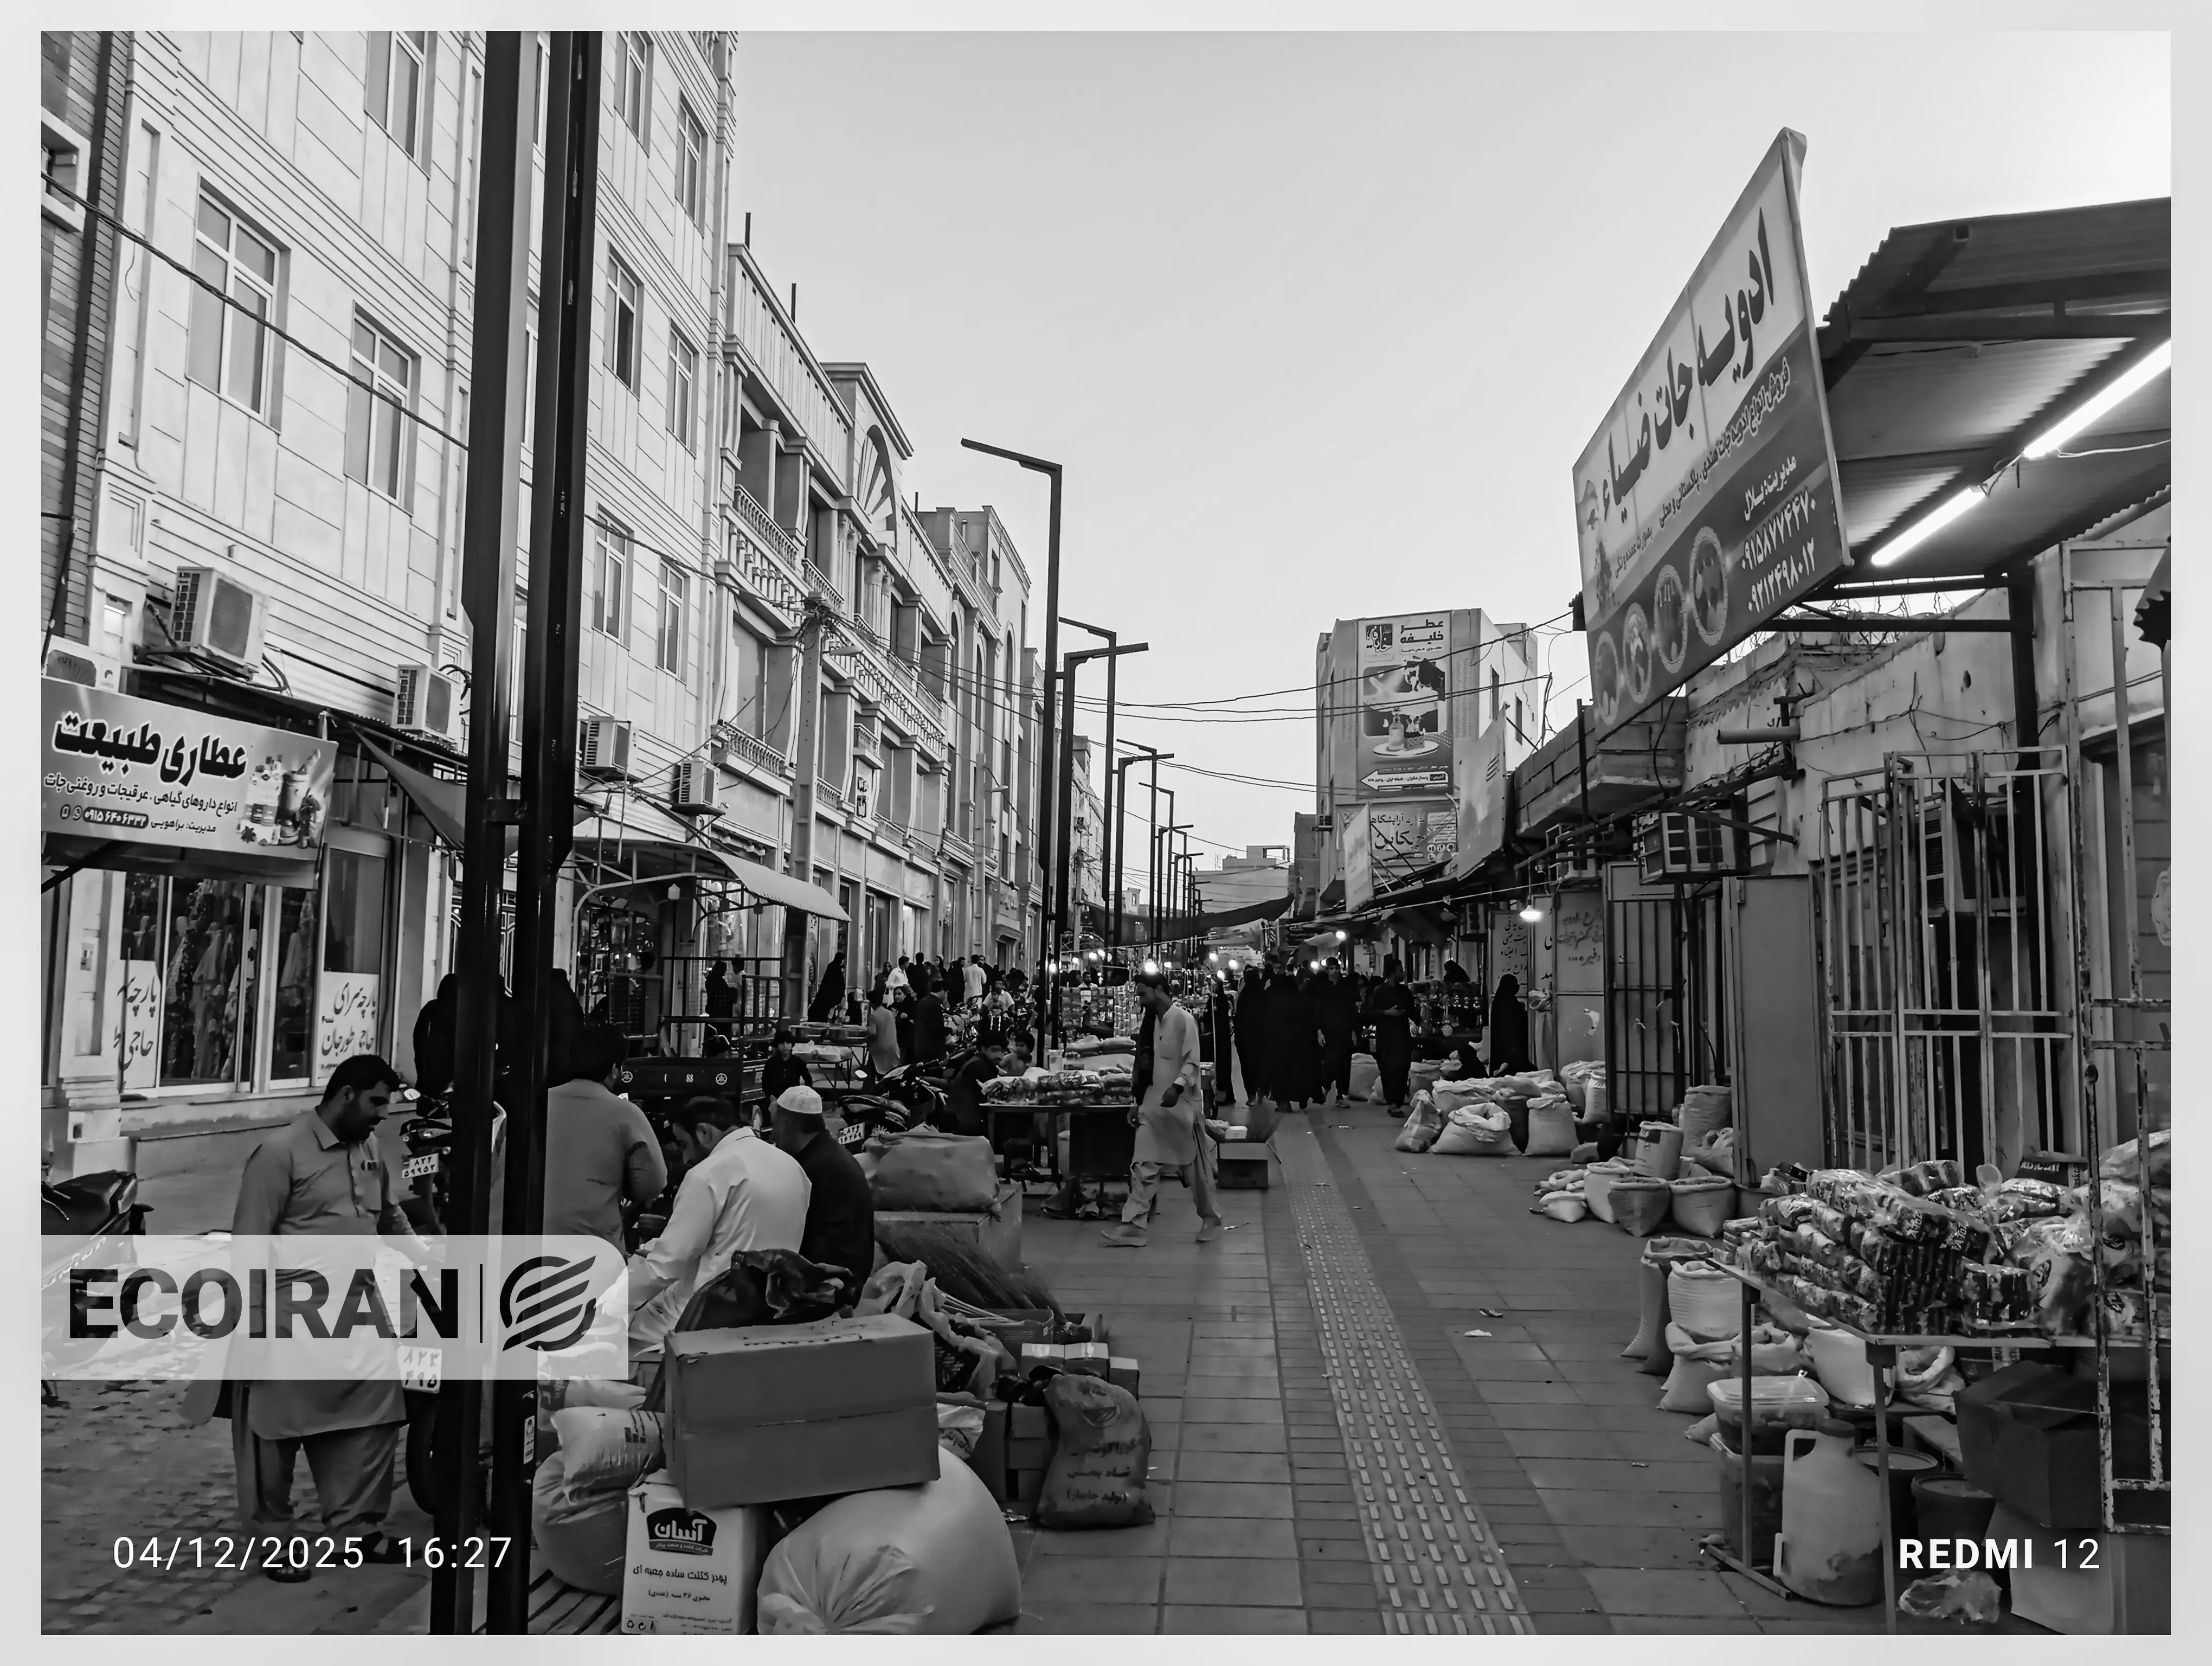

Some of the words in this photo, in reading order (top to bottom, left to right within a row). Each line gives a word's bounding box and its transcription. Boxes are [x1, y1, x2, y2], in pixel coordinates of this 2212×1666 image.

[1766, 357, 1789, 412] فروش
[1655, 347, 1694, 450] جات
[1749, 385, 1766, 436] انواع
[1744, 484, 1765, 521] بلال
[1401, 619, 1443, 634] عطر
[1400, 631, 1443, 644] خلیفه
[54, 714, 162, 775] طبیعت
[160, 735, 247, 787] عطاری
[44, 773, 66, 791] جات
[66, 779, 98, 797] روغنی
[99, 784, 105, 797] و
[153, 790, 182, 805] گیاهی
[182, 794, 217, 811] داروهای
[216, 802, 238, 817] انواع
[127, 976, 157, 1017] پارچه
[334, 982, 363, 1016] سرای
[356, 985, 375, 1018] پارچه
[654, 1518, 708, 1541] آسان
[633, 1565, 642, 1575] ای
[645, 1567, 664, 1578] جعبه
[666, 1568, 685, 1579] ساده
[687, 1571, 709, 1581] کتلت
[712, 1575, 728, 1586] پودر
